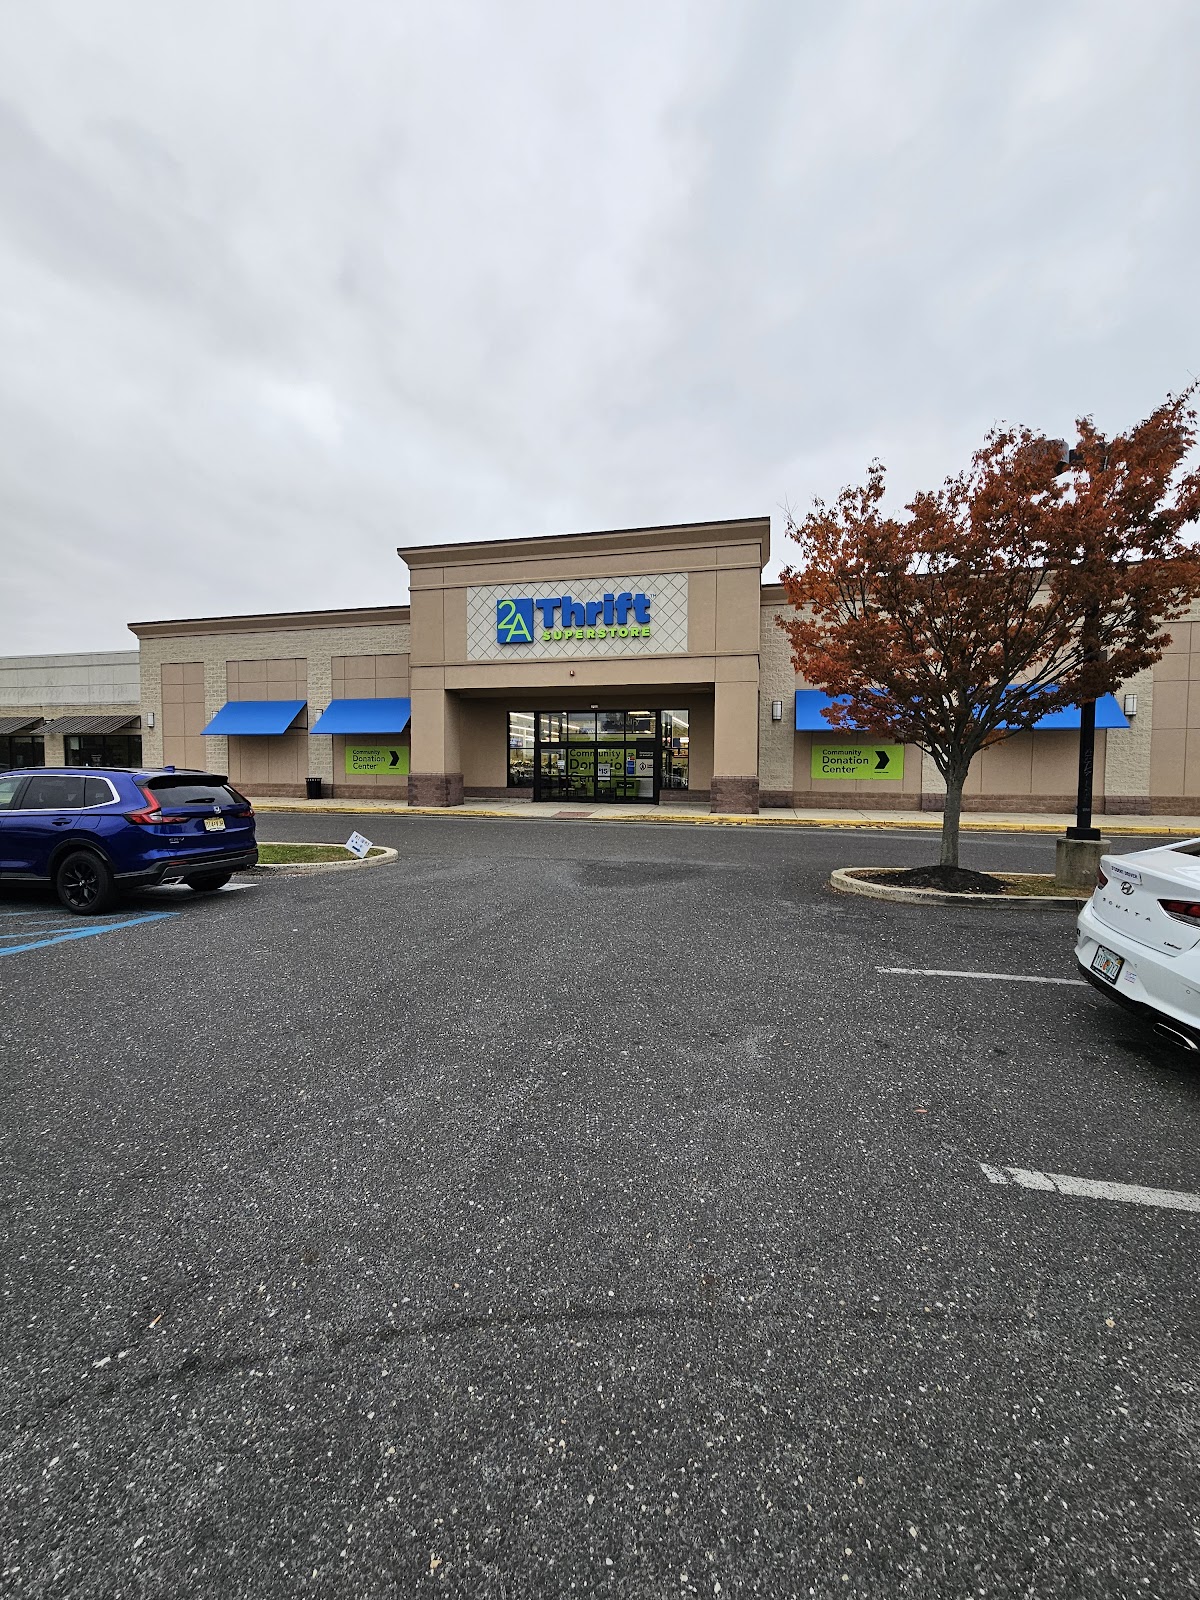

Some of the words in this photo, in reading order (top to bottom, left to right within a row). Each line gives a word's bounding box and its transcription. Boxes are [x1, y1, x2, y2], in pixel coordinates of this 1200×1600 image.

[498, 600, 532, 642] 2A
[536, 592, 651, 628] Thrift
[542, 627, 651, 641] SUPERSTORE
[822, 756, 869, 765] Donation
[822, 764, 856, 773] Center
